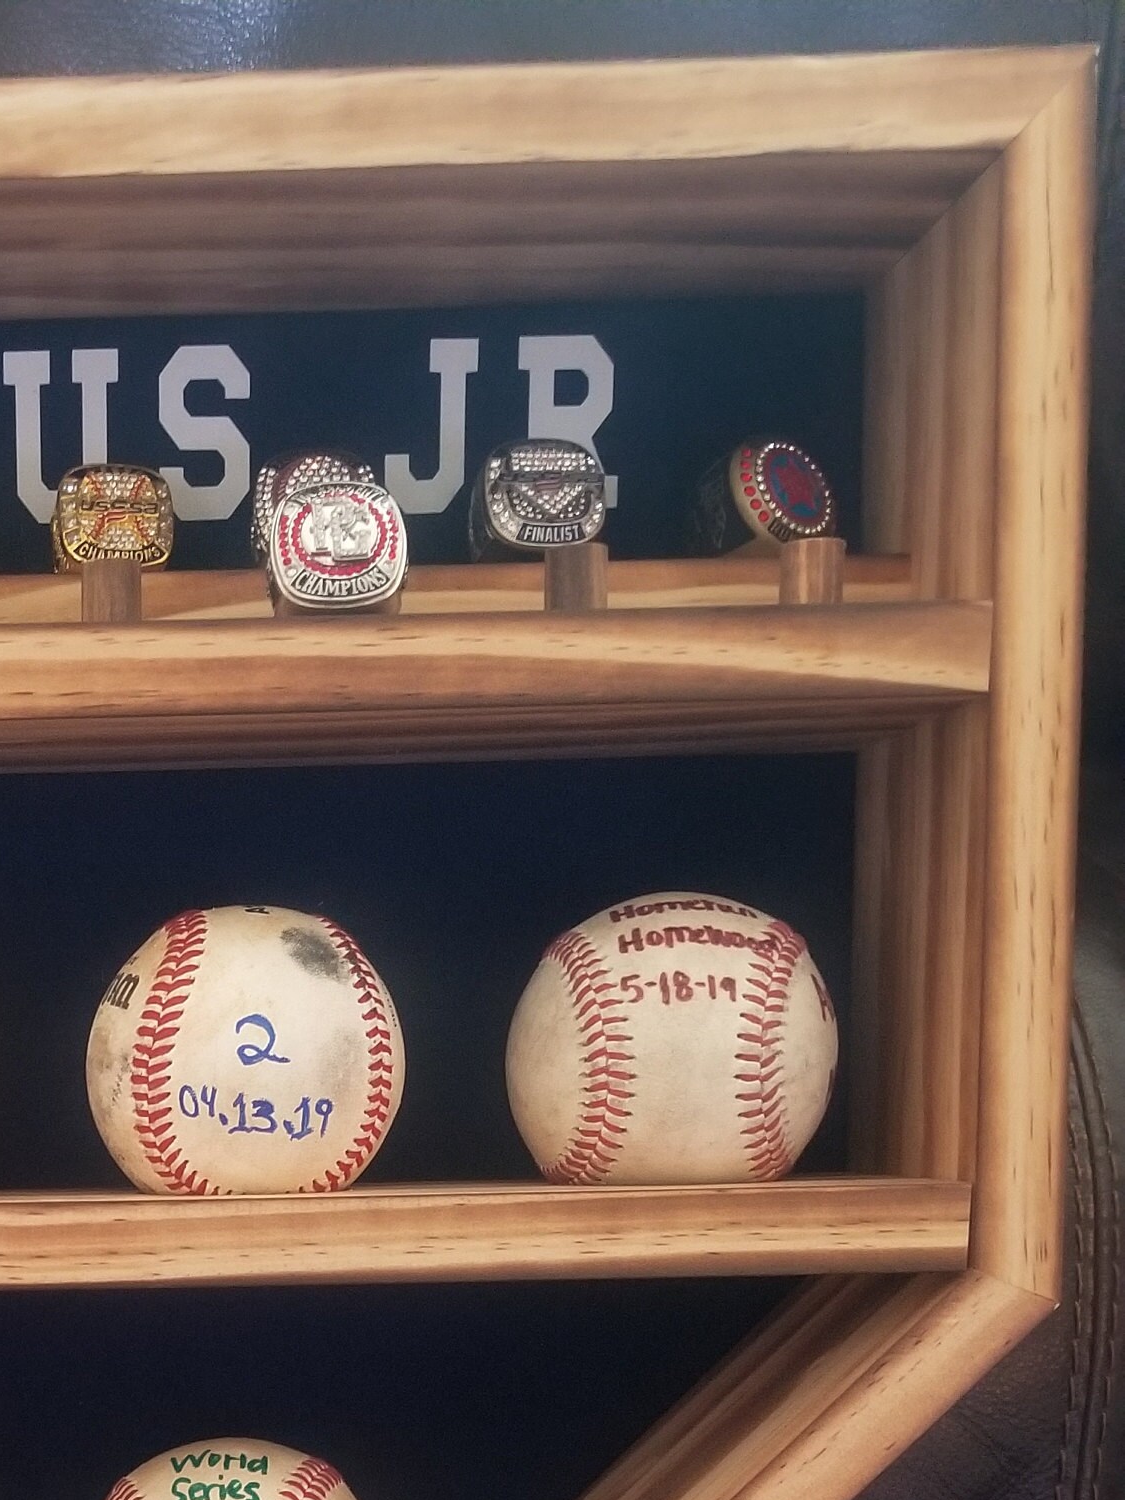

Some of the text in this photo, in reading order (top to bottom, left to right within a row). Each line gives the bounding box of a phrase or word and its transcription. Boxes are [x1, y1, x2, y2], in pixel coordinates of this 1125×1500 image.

[384, 334, 618, 515] JR
[523, 524, 580, 543] FINALIST
[295, 568, 388, 597] CHAMPIONS
[608, 898, 758, 924] Homerun
[620, 969, 738, 1006] 5-18-19
[235, 1012, 291, 1067] 2
[177, 1083, 335, 1142] 04.13.19
[170, 1448, 270, 1476] World
